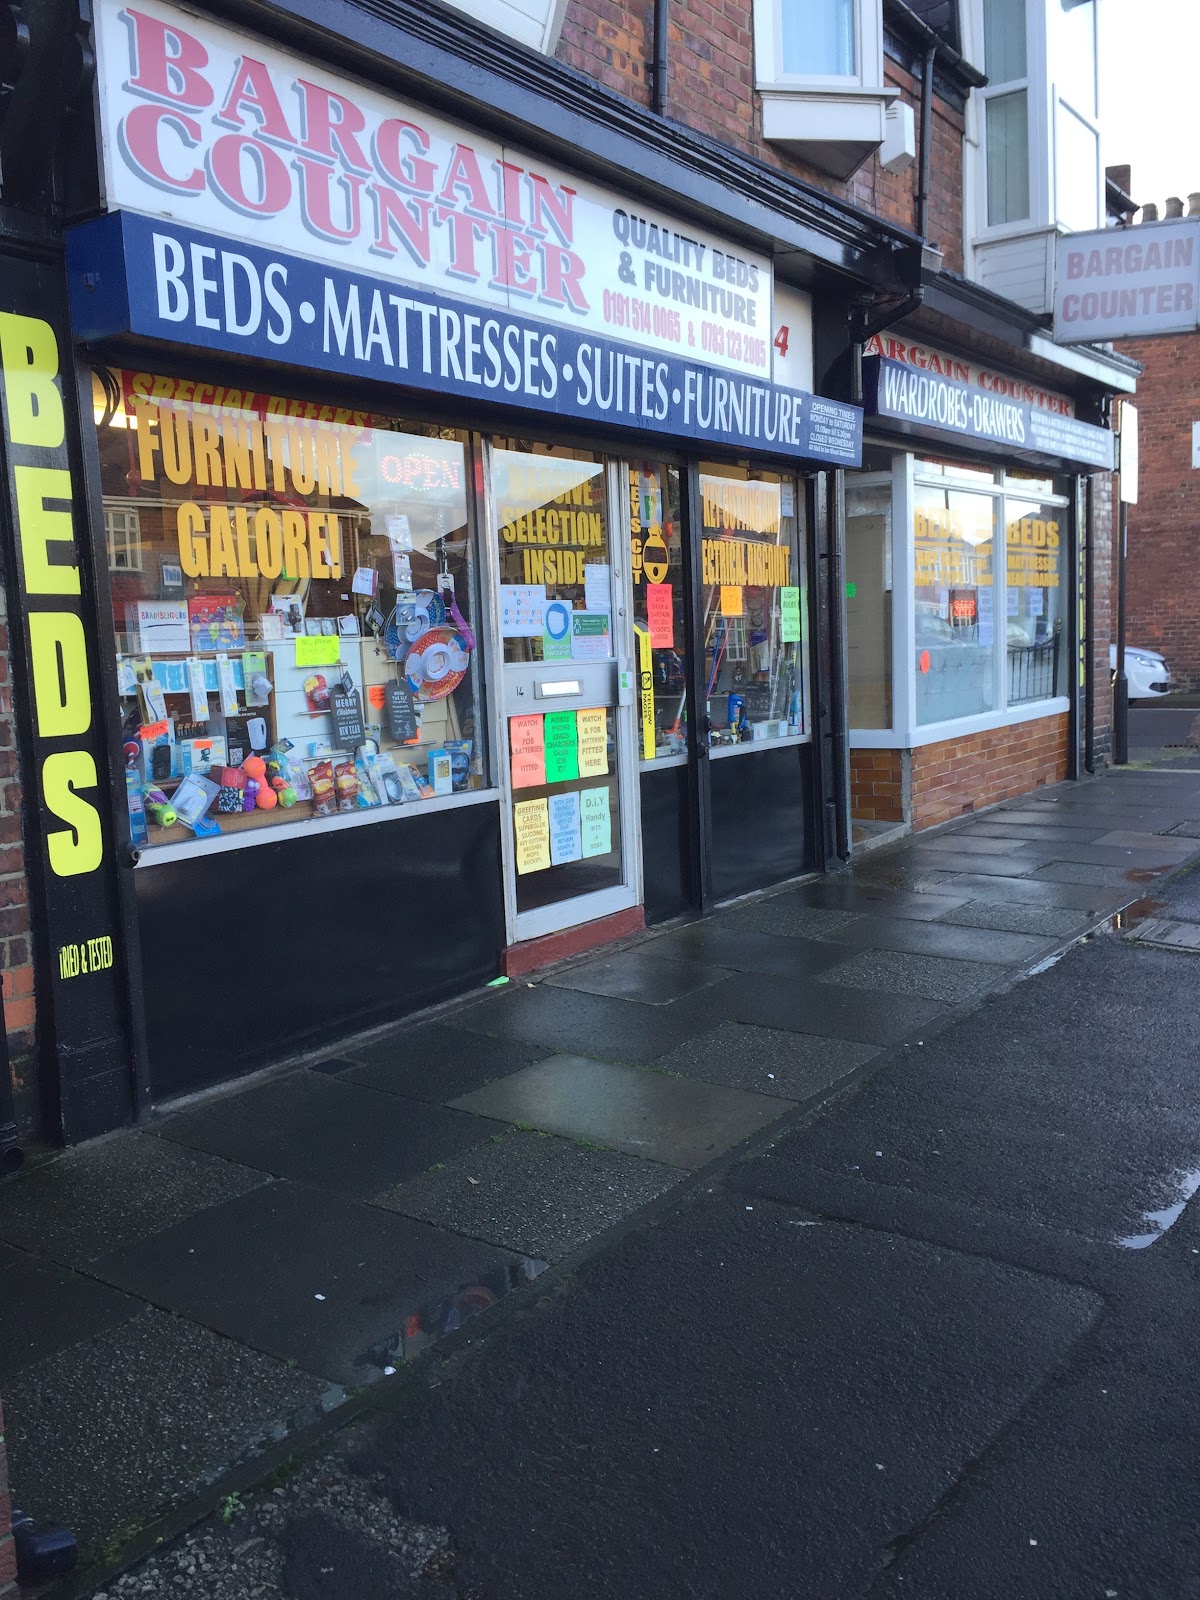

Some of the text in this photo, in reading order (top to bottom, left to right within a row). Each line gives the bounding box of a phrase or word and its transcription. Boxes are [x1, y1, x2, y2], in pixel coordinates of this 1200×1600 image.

[119, 8, 577, 247] BARGAIN
[117, 104, 591, 315] COUNTER
[612, 208, 759, 293] QUALITY BEDS
[1066, 236, 1194, 281] BARGAIN
[618, 251, 757, 327] & FURNITURE
[1062, 282, 1194, 323] COUNTER
[153, 232, 802, 446] BEDS MATTRESSES SUITES FURNITURE
[603, 288, 630, 328] 0191
[632, 298, 652, 335] 514
[653, 305, 681, 343] 0065
[687, 321, 696, 347] &
[726, 329, 742, 361] 123
[867, 335, 1071, 417] ARGAIN COUNTER
[129, 371, 368, 437] SPECIAL OFFERS
[813, 402, 856, 420] OPENING TIMES
[884, 365, 968, 429] WARDROBES
[973, 394, 1026, 444] DRAWERS
[811, 413, 829, 425] MONDAY
[835, 419, 856, 431] SATURDAY
[134, 401, 361, 498] FURNITURE
[811, 432, 855, 448] CLOSED WEDNESDAY
[381, 455, 461, 489] OPEN
[508, 464, 593, 507] MASSIVE
[703, 483, 721, 528] KEY
[502, 505, 602, 547] SELECTION
[628, 469, 643, 584] KEYS CUT
[914, 507, 963, 538] BEDS
[1006, 518, 1060, 547] BEDS
[177, 501, 342, 580] GALORE!
[523, 548, 586, 585] INSIDE
[701, 539, 790, 587] ECTRICAL DISCOUNT
[0, 310, 104, 878] BEDS
[783, 600, 797, 608] BULBS
[784, 590, 797, 599] LIGHT
[142, 611, 187, 620] BRAINBENDERS
[336, 698, 357, 708] MERRY
[583, 715, 602, 723] WATCH
[518, 719, 538, 728] WATCH
[516, 746, 542, 755] BATTERIES
[583, 746, 604, 755] FITTED
[586, 759, 602, 767] HERE
[521, 763, 539, 772] FITTED
[518, 803, 545, 814] GREETING
[523, 813, 542, 823] CARDS
[586, 796, 605, 809] D.I.Y
[586, 812, 606, 823] Handy
[519, 821, 546, 832] SUPERGLUE
[522, 830, 543, 839] SILICONE
[529, 835, 547, 844] CUTTING
[80, 944, 89, 974] &
[87, 936, 113, 972] TESTED
